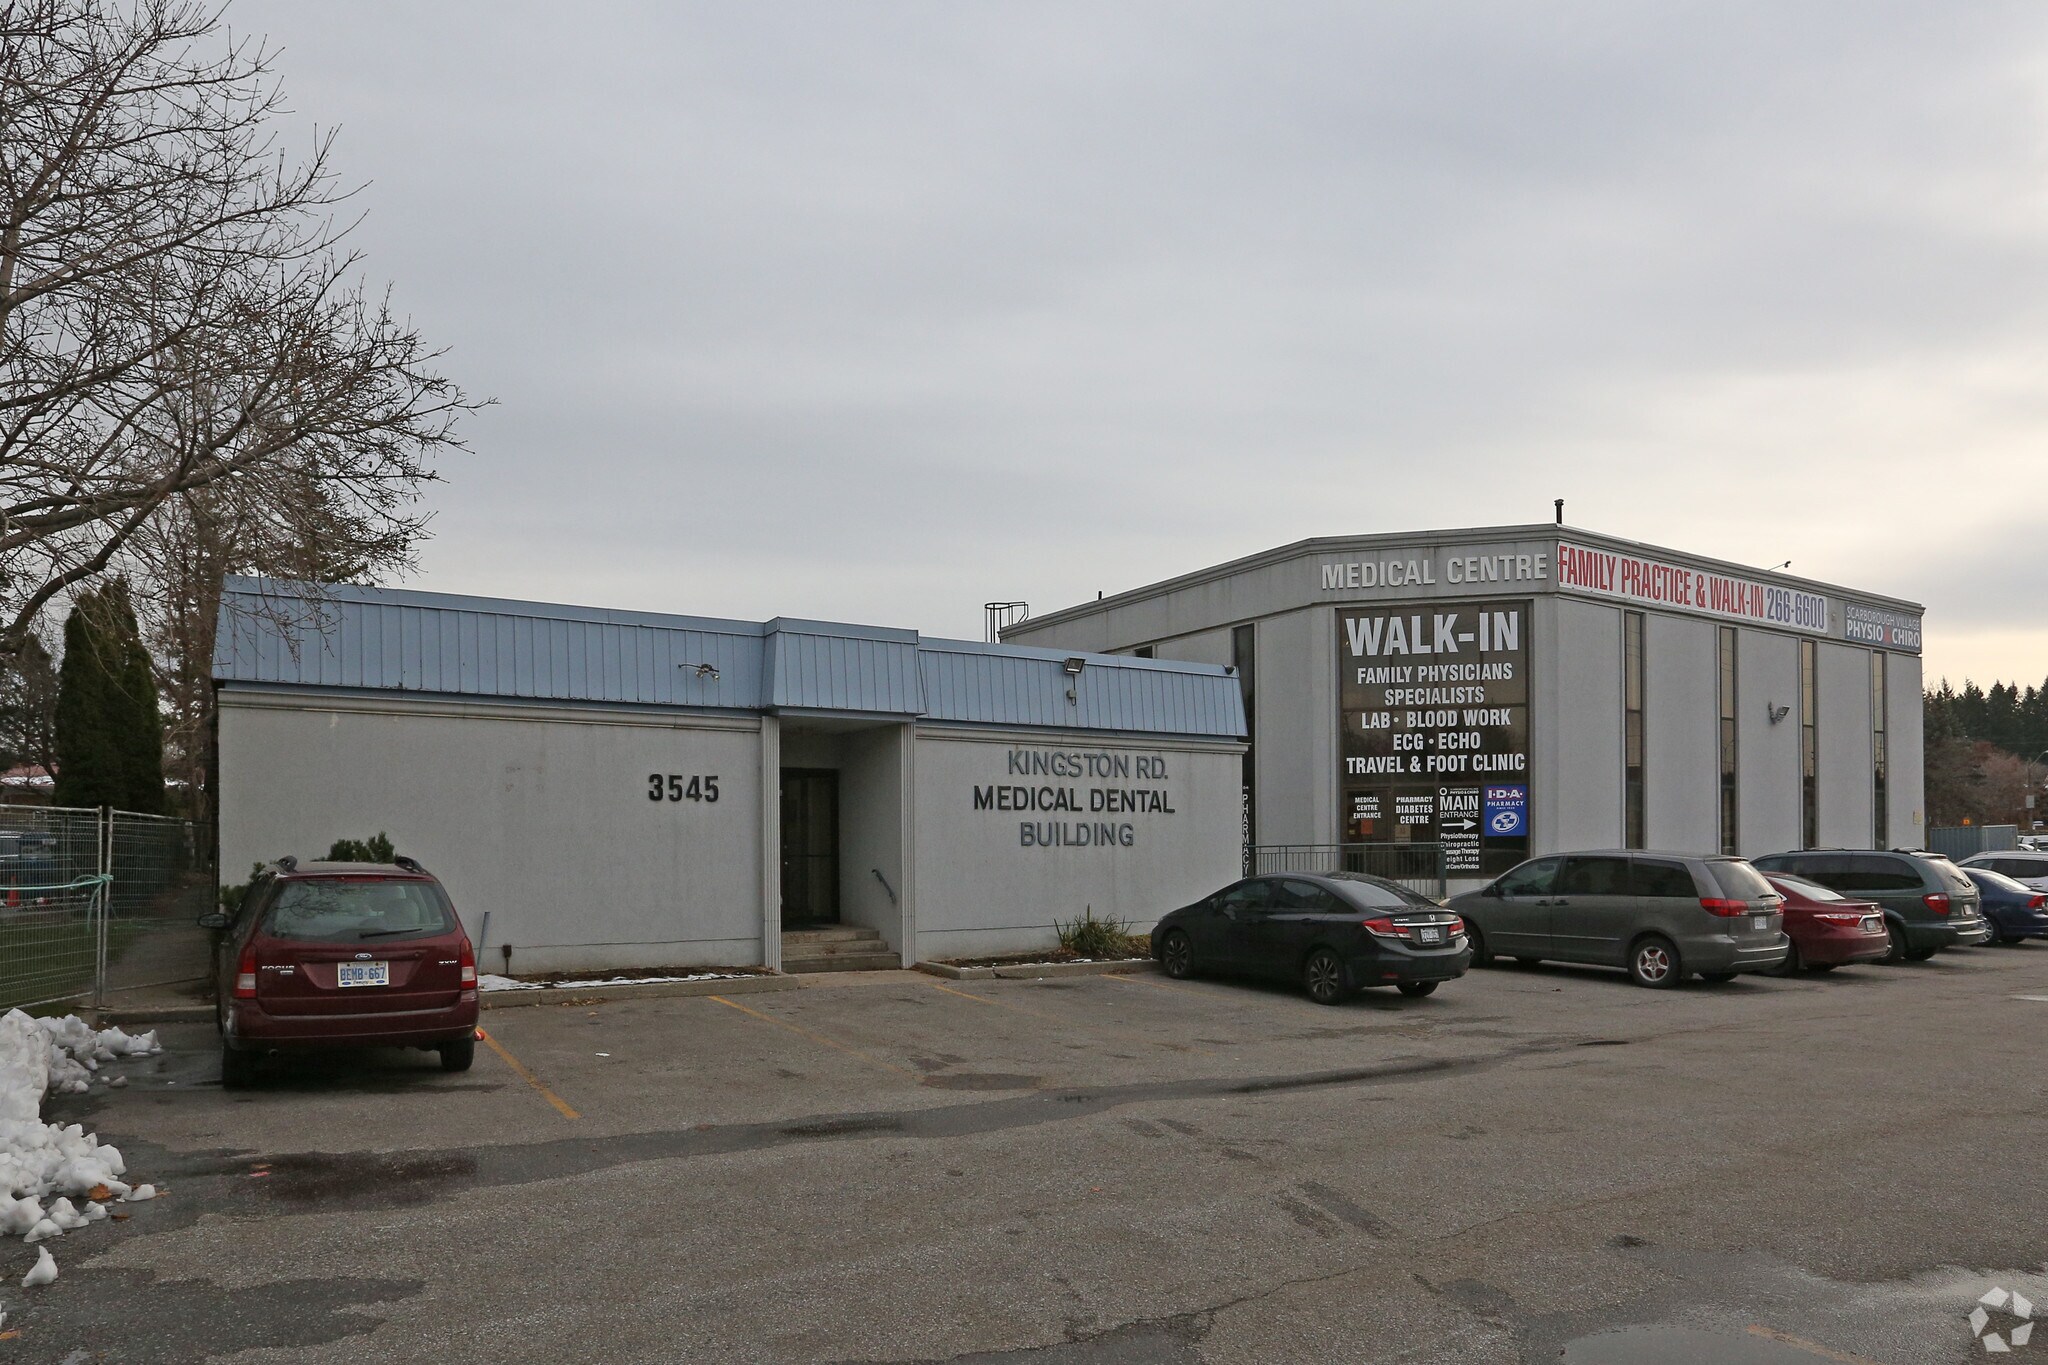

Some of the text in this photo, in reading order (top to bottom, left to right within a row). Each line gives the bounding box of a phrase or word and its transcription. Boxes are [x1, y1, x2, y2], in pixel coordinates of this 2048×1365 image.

[1321, 553, 1548, 590] MEDICAL CENTRE
[1559, 545, 1825, 630] FAMILY PRACTICE & WALK-IN 266-6600
[1846, 606, 1895, 626] SCARBOROUGH
[1345, 611, 1519, 657] WALK-IN
[1846, 619, 1920, 648] PHYSIO CHIRO
[1357, 662, 1513, 684] FAMILY PHYSICIANS
[1384, 686, 1485, 706] SPECIALISTS
[1361, 708, 1511, 729] LAB BLOOD WORK
[1393, 731, 1481, 750] ECG ECHO
[1008, 750, 1169, 780] KINGSTON RD.
[1346, 753, 1526, 774] TRAVEL & FOOT CLINIC
[648, 773, 719, 803] 3545
[973, 785, 1176, 814] MEDICAL DENTAL
[1395, 804, 1434, 814] DIABETES
[1440, 795, 1479, 811] MAIN
[1353, 811, 1382, 819] ENTRANCE
[1400, 815, 1429, 824] CENTRE
[1440, 811, 1479, 819] ENTRANCE
[1020, 821, 1134, 847] BUILDING
[1242, 793, 1250, 875] PHARMACY
[1440, 832, 1479, 840] Physiotherapy
